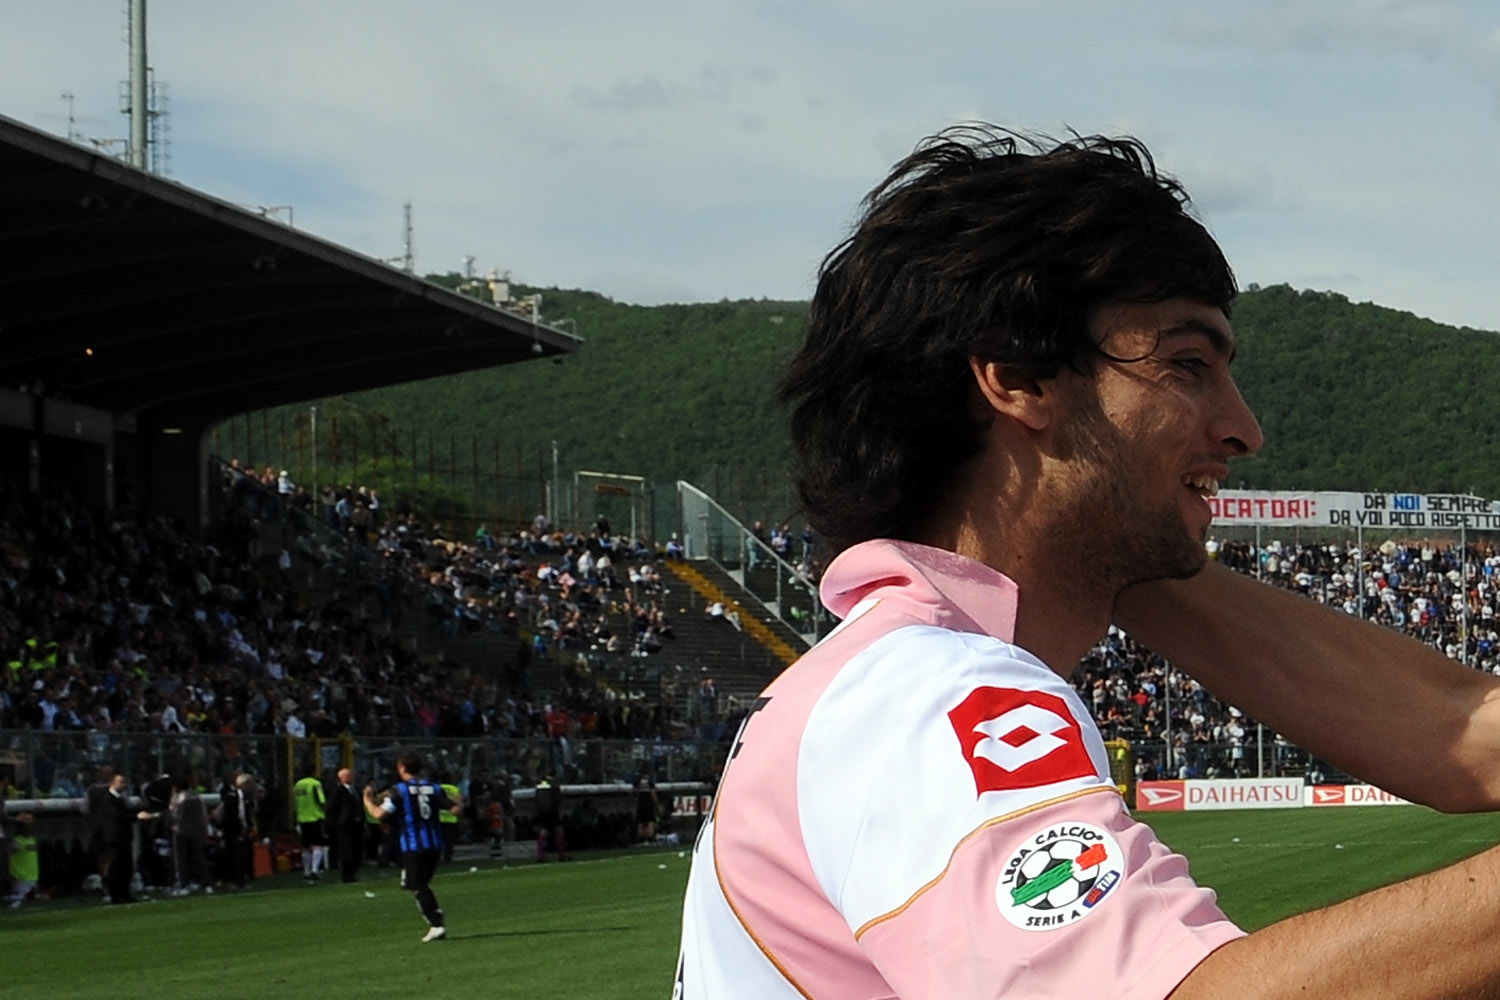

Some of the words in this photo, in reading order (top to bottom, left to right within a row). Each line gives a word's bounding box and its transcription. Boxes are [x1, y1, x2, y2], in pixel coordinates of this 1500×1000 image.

[1207, 498, 1317, 519] OCATORI:
[1364, 494, 1386, 511] DA
[1393, 495, 1421, 511] NOI
[1427, 496, 1492, 514] SEMPRE
[1329, 510, 1351, 525] DA
[1356, 511, 1383, 526] VOI
[1389, 512, 1425, 527] POCO
[1189, 785, 1299, 804] DAIHATSU
[417, 794, 432, 820] 6
[1002, 848, 1033, 886] LEGA
[1025, 913, 1065, 927] SERIE
[1071, 909, 1082, 920] A
